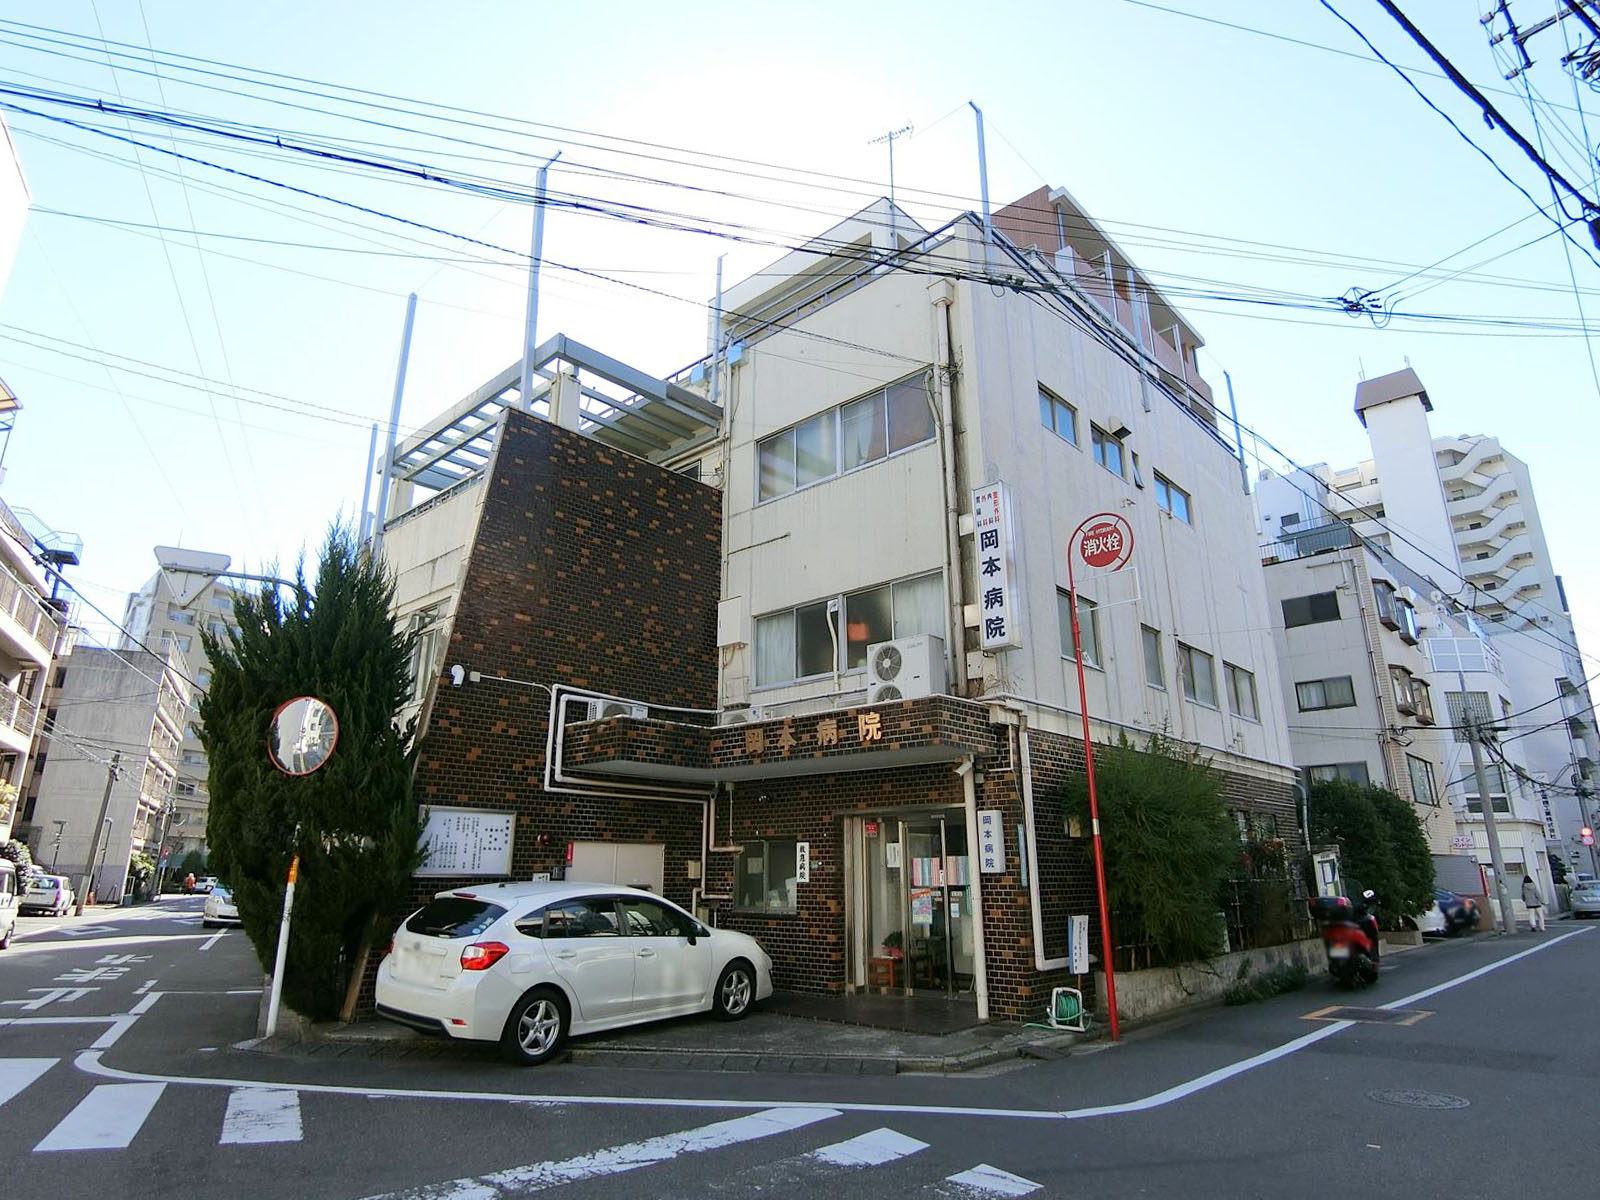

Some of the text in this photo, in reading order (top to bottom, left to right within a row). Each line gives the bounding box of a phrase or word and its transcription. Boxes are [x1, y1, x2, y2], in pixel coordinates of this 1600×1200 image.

[1083, 532, 1121, 558] 消火栓
[980, 528, 1006, 640] 岡本病院
[744, 711, 882, 755] 岡本病院
[798, 844, 807, 880] 救急病院
[982, 815, 995, 868] 岡本病院
